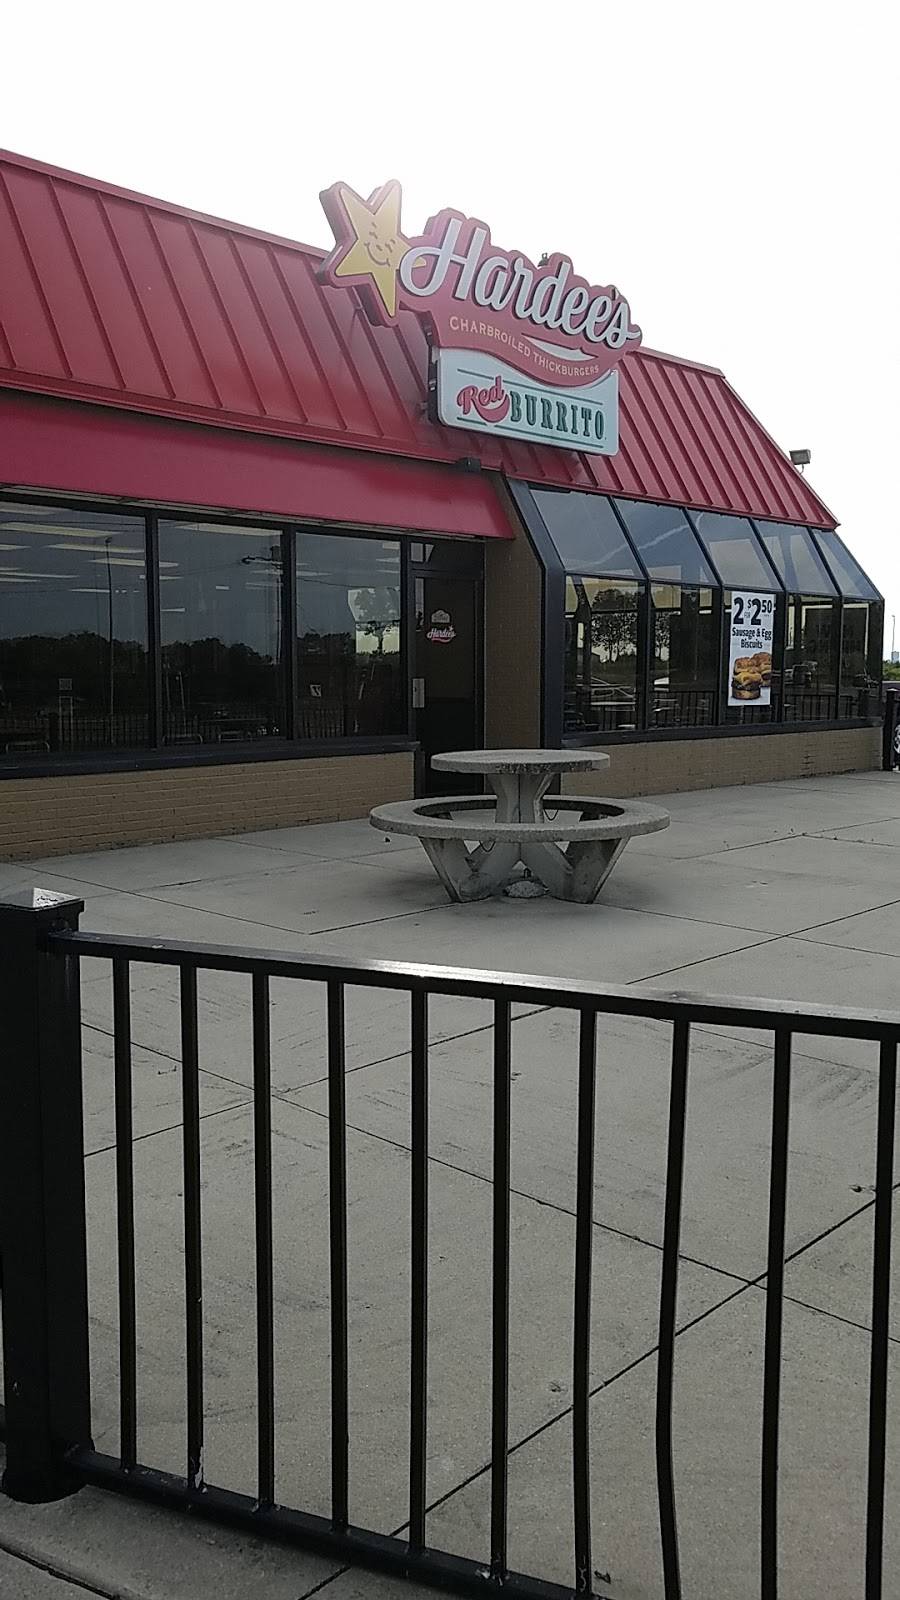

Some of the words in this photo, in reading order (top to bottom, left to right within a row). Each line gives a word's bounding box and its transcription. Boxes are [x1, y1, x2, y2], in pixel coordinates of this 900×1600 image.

[449, 315, 531, 358] CHARBROILED
[532, 350, 599, 377] THICKBURGERS
[457, 376, 508, 418] Red
[509, 390, 606, 440] BURRITO
[733, 597, 744, 624] 2
[732, 627, 756, 640] Sausage
[756, 629, 761, 637] &
[762, 628, 772, 641] Egg
[740, 639, 763, 648] Biscuits
